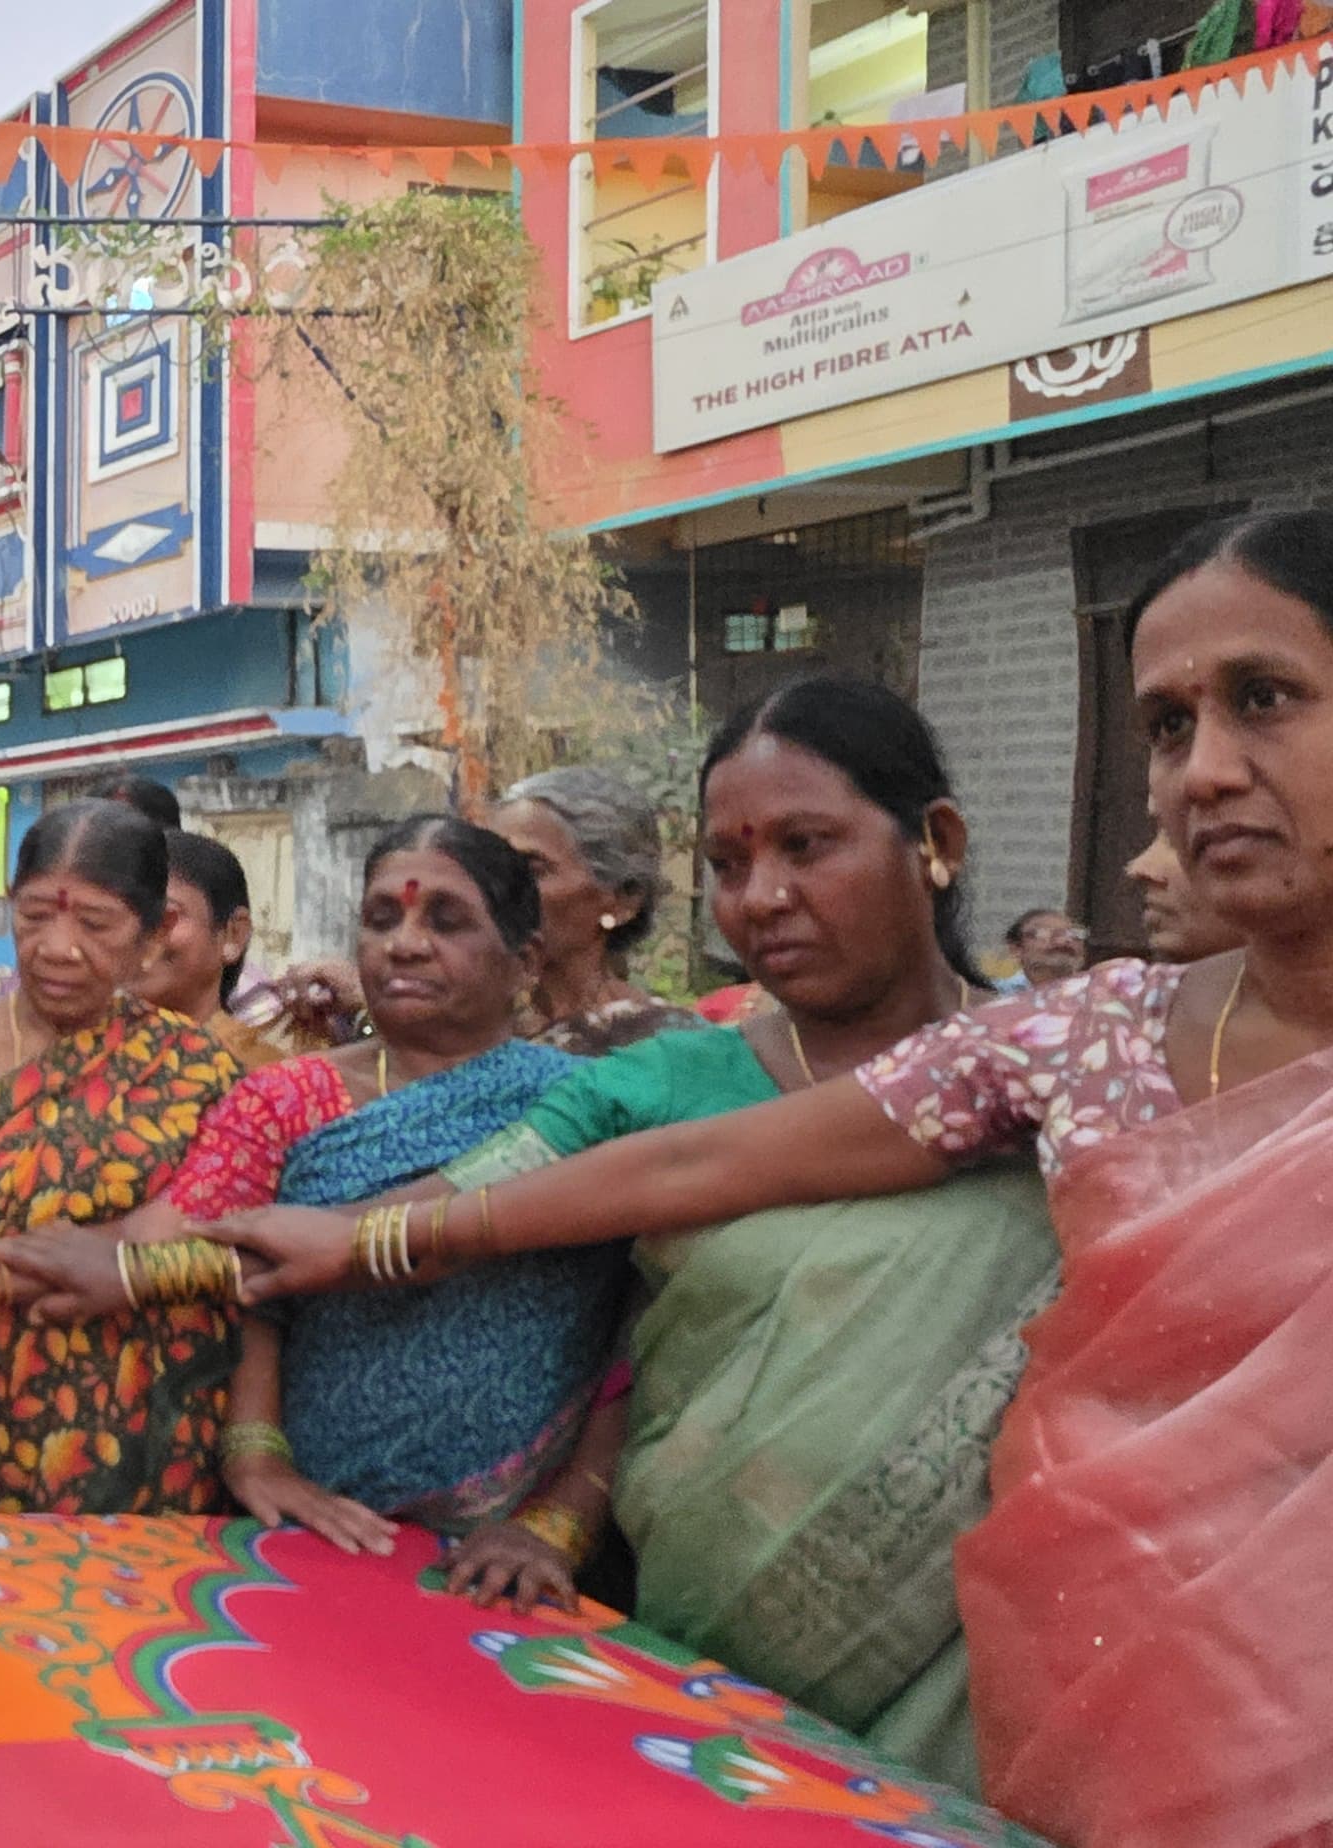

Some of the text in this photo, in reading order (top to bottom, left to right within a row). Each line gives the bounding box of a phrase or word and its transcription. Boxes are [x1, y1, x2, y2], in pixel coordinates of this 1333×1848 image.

[744, 257, 906, 322] AASHIRVAAD
[763, 306, 890, 355] Multigrains
[789, 310, 830, 330] Atta
[692, 320, 973, 413] THE HIGH FIBRE ATTA
